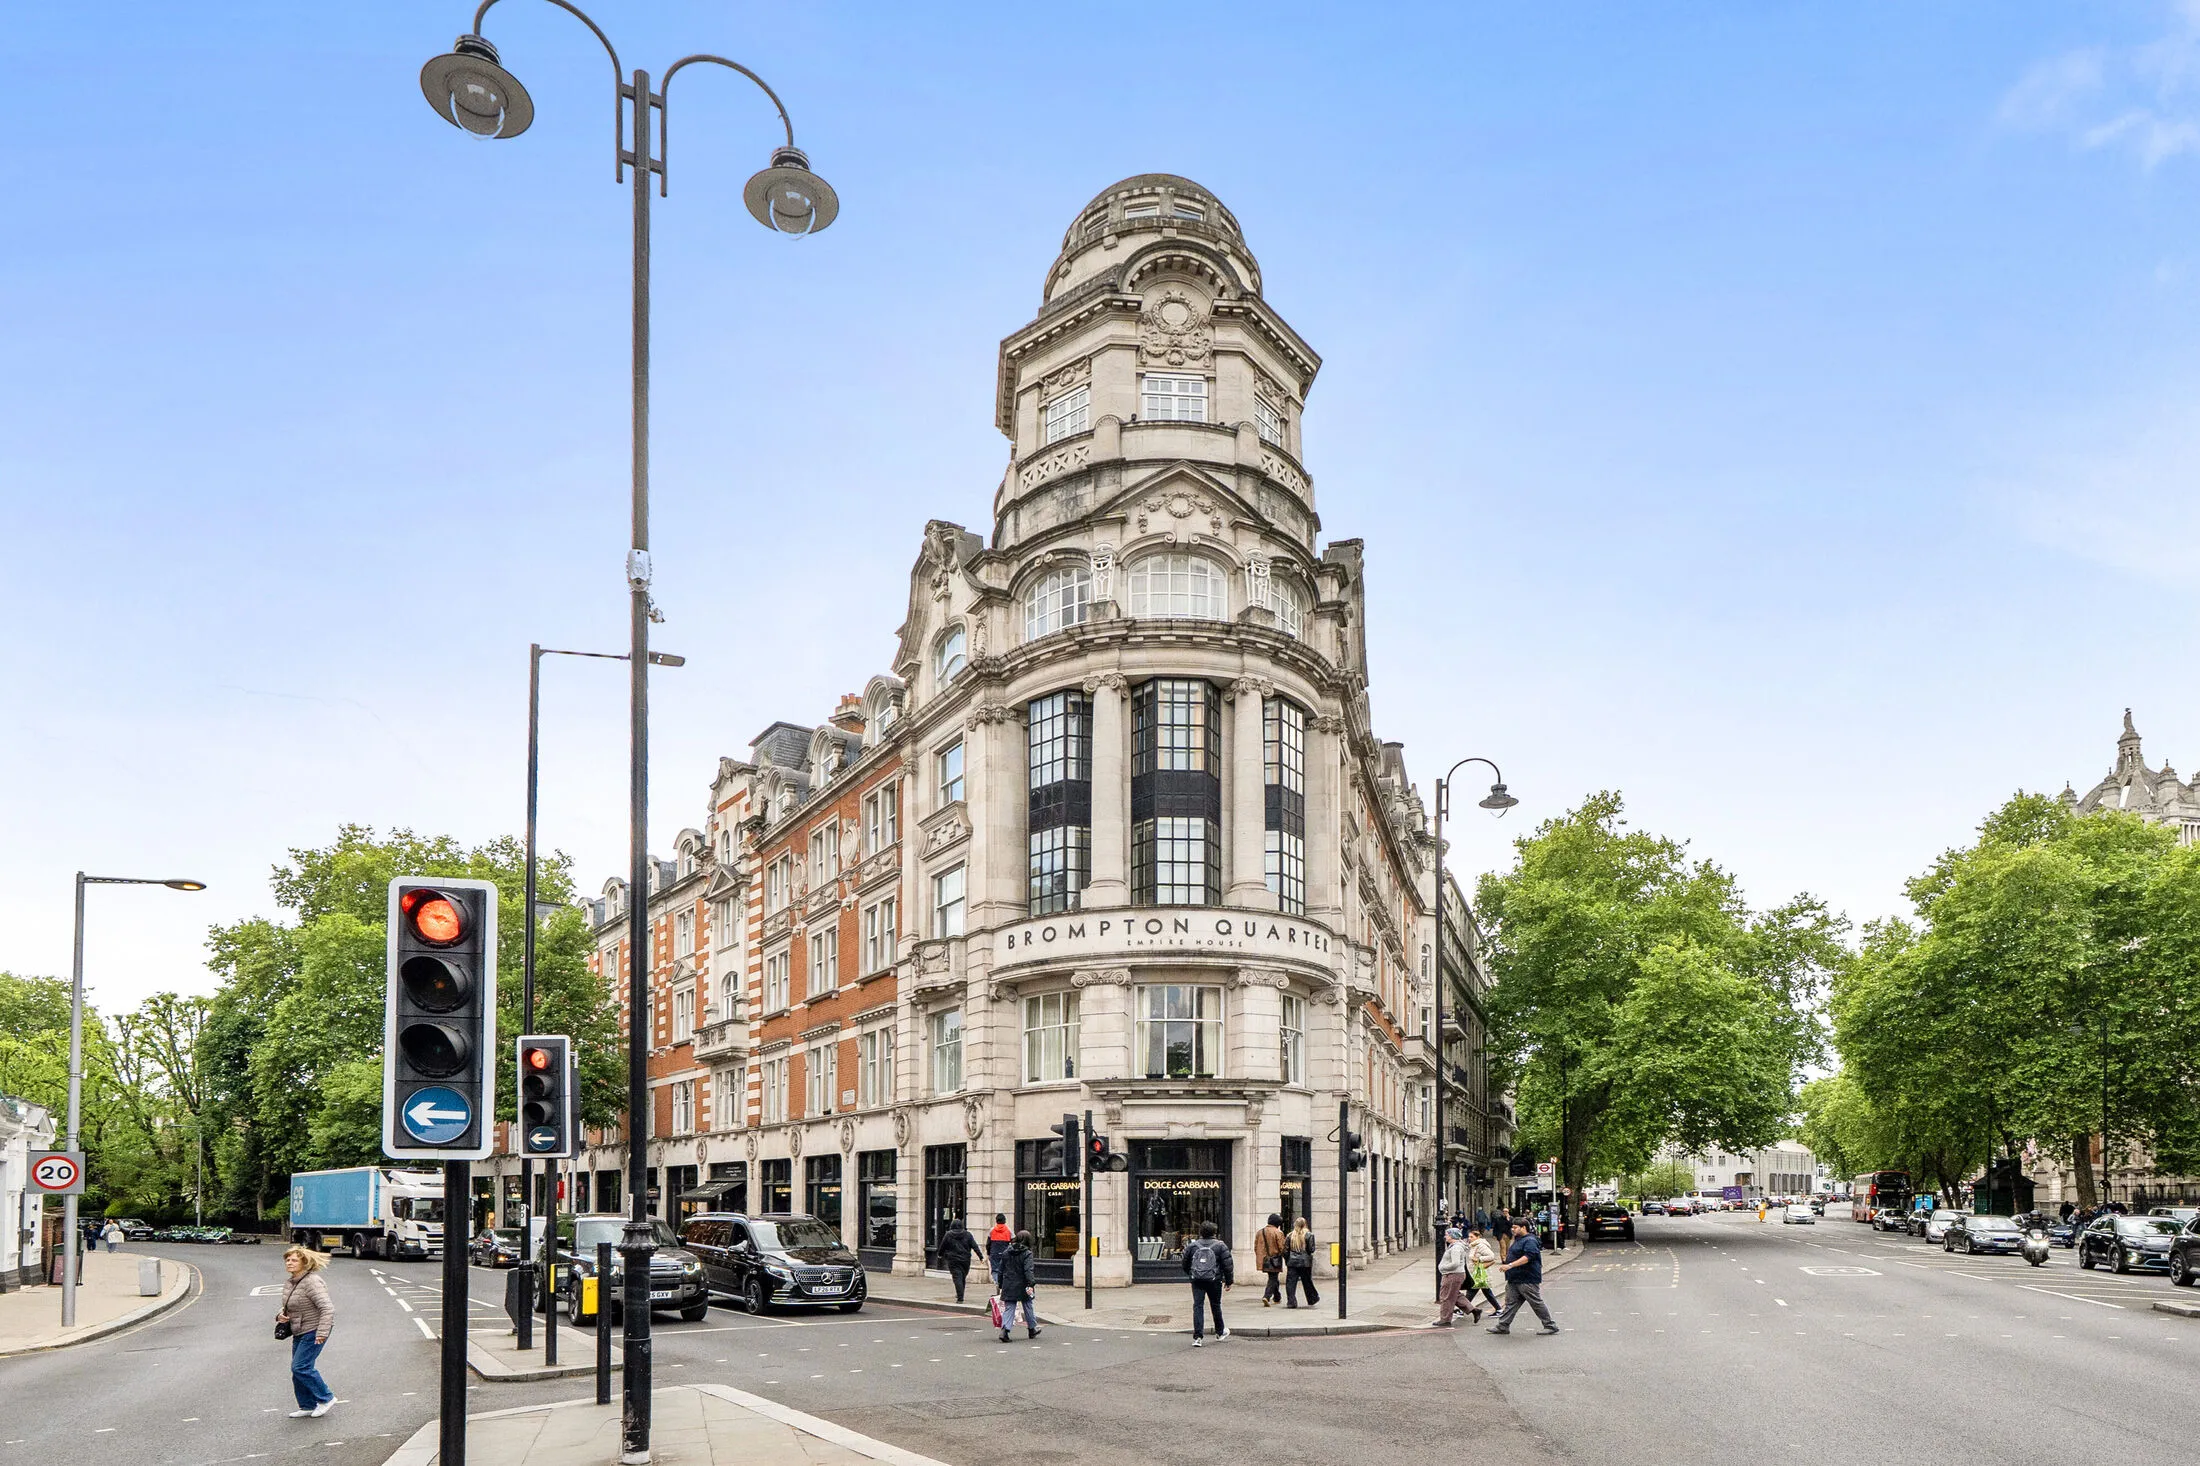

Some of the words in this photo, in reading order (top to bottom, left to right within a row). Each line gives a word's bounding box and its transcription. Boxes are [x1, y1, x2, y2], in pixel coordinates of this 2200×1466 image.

[1007, 917, 1189, 950] BROMPTON
[1215, 919, 1328, 953] QUARTER
[1196, 939, 1242, 947] HOUSE
[40, 1165, 72, 1180] 20
